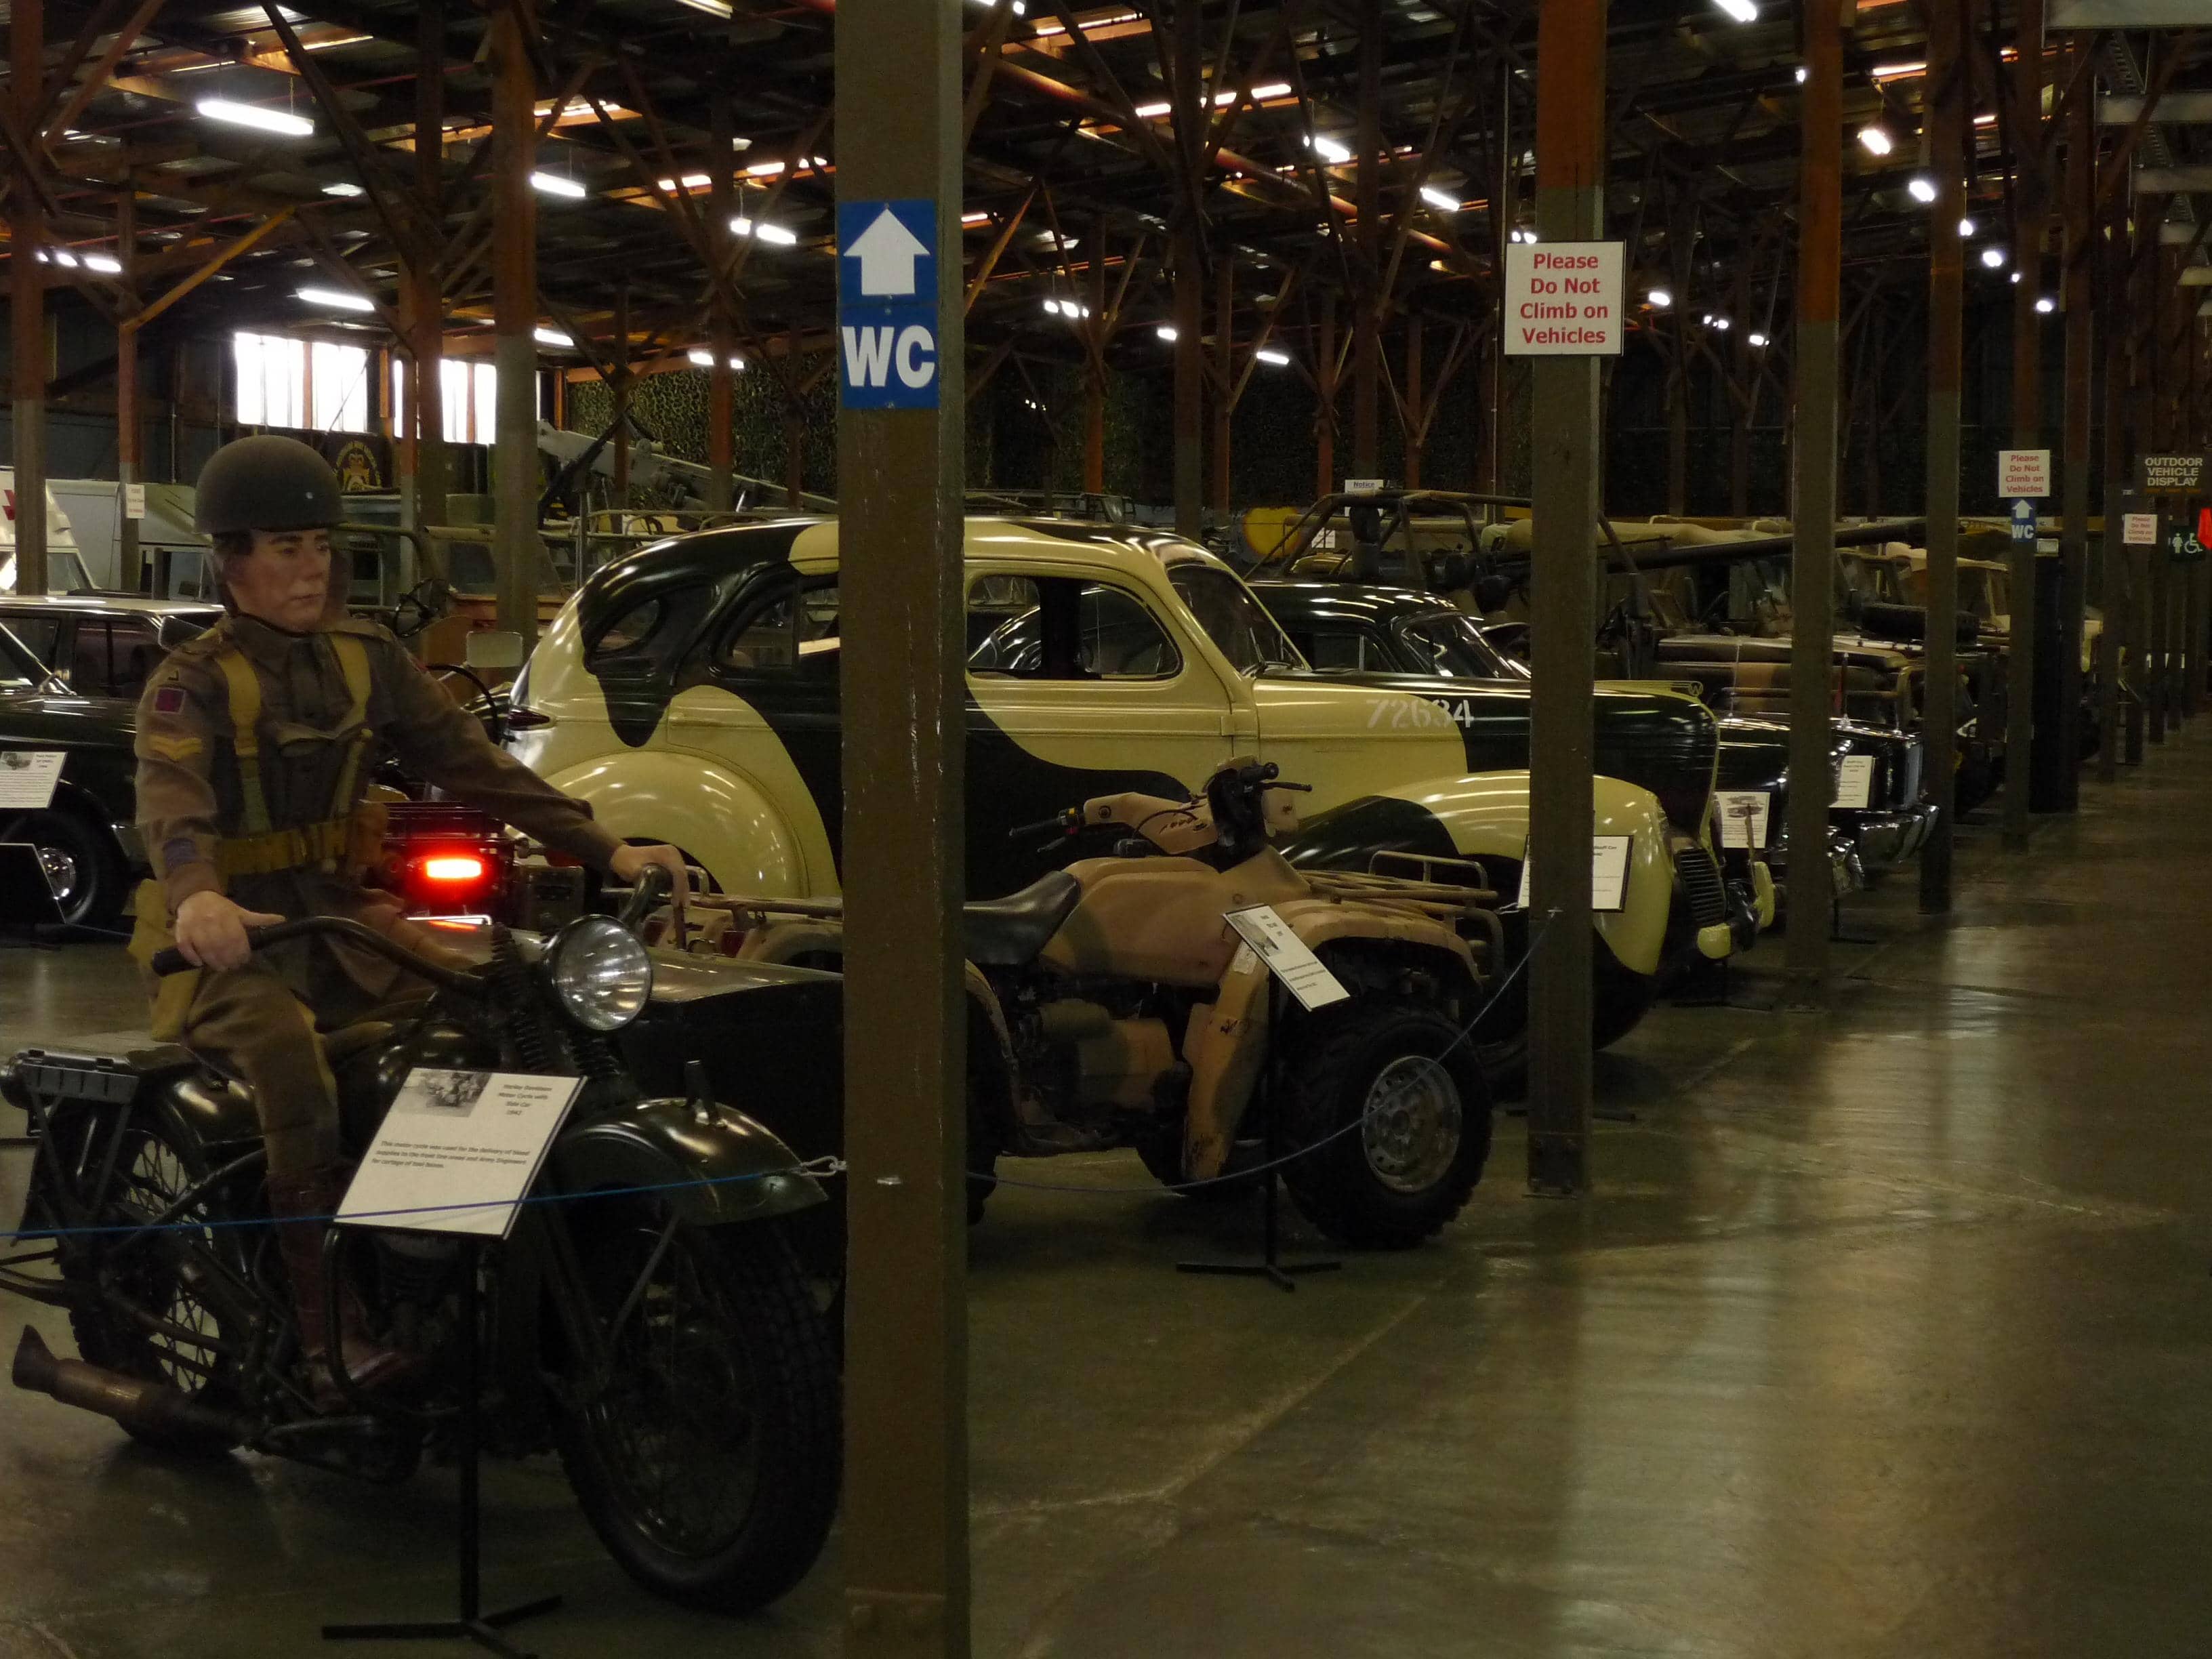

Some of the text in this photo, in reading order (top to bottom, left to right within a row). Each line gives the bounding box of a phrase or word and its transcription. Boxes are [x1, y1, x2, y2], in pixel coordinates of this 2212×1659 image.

[1534, 253, 1599, 269] Please
[1531, 278, 1601, 294] Do Not
[1520, 302, 1608, 319] Climb on
[1522, 327, 1606, 344] Vehicles
[842, 325, 935, 389] WC
[2145, 457, 2203, 466] OUTDOOR
[2147, 467, 2199, 476] VEHICLE
[2147, 477, 2198, 487] DISPLAY
[2011, 525, 2034, 539] WC
[1366, 699, 1474, 728] 72634
